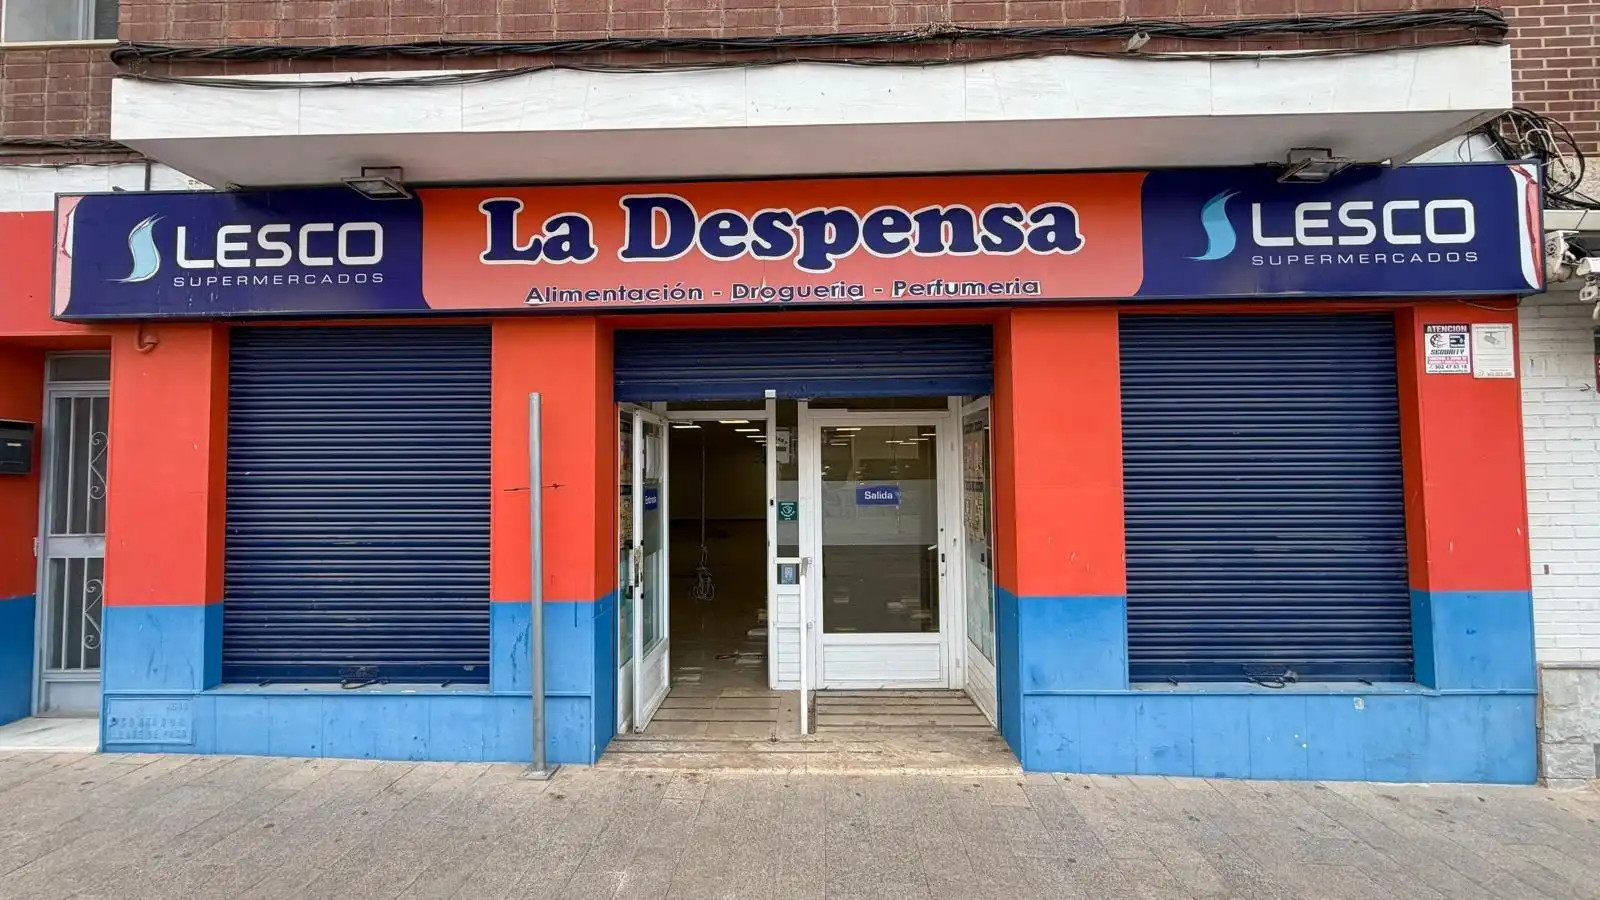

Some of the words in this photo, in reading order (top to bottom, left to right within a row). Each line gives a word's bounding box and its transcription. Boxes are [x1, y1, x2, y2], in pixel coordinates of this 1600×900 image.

[1251, 199, 1476, 247] LESCO
[479, 198, 598, 265] La
[617, 193, 1085, 274] Despensa
[176, 222, 384, 269] LESCO
[1251, 251, 1479, 267] SUPERMERCADOS
[173, 272, 385, 288] SUPERMERCADOS
[525, 282, 703, 305] Alimentación
[1426, 325, 1467, 333] ATENCION
[864, 490, 893, 500] Salida
